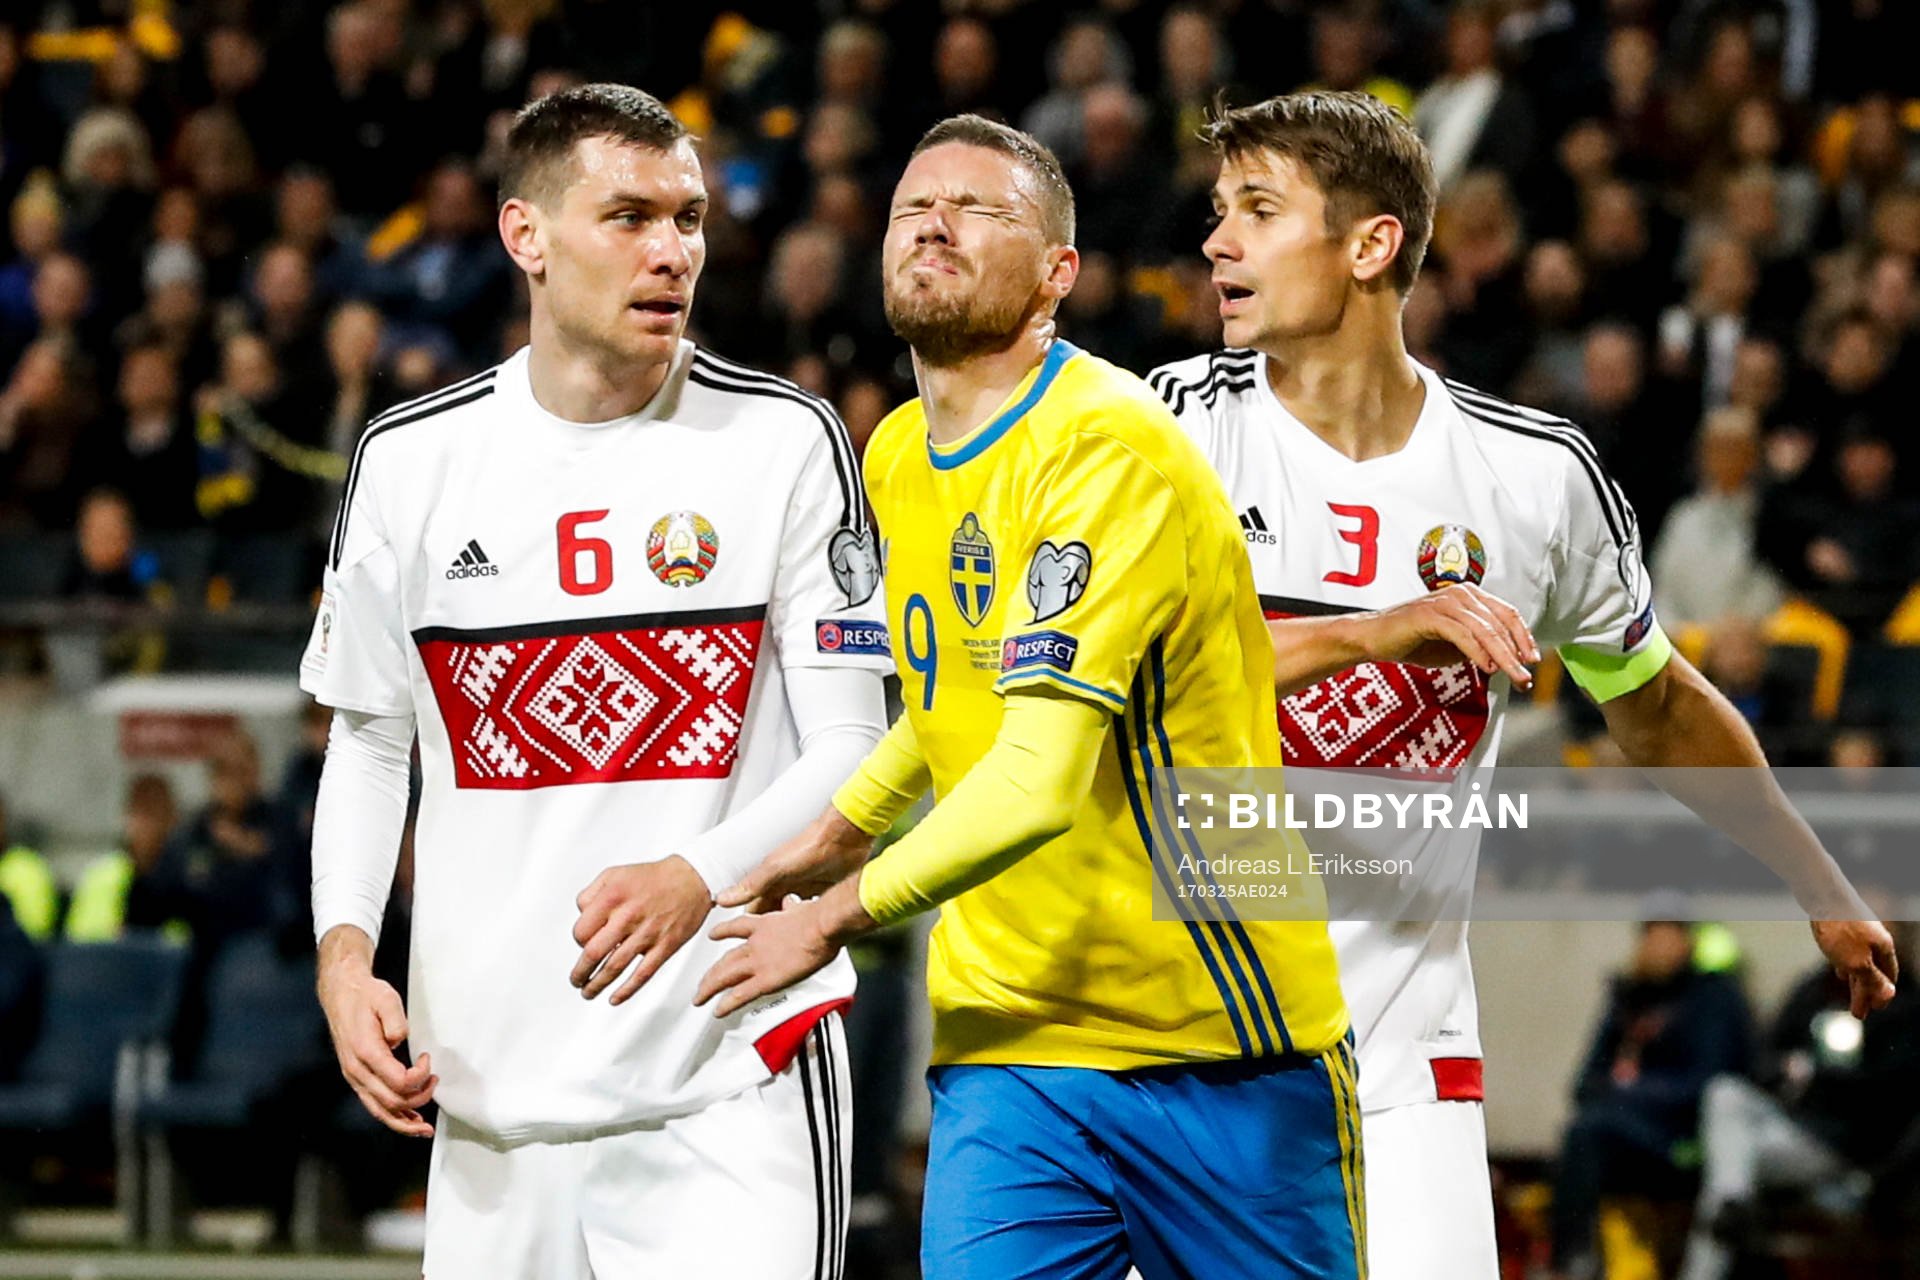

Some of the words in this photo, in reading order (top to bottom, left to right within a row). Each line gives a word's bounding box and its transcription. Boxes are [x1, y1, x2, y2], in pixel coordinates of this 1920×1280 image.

[1245, 530, 1277, 545] das
[1323, 501, 1380, 588] 3
[556, 509, 613, 596] 6
[445, 563, 499, 580] adidas
[843, 629, 890, 647] RESPE
[904, 593, 938, 711] 9
[1016, 639, 1076, 662] RESPECT
